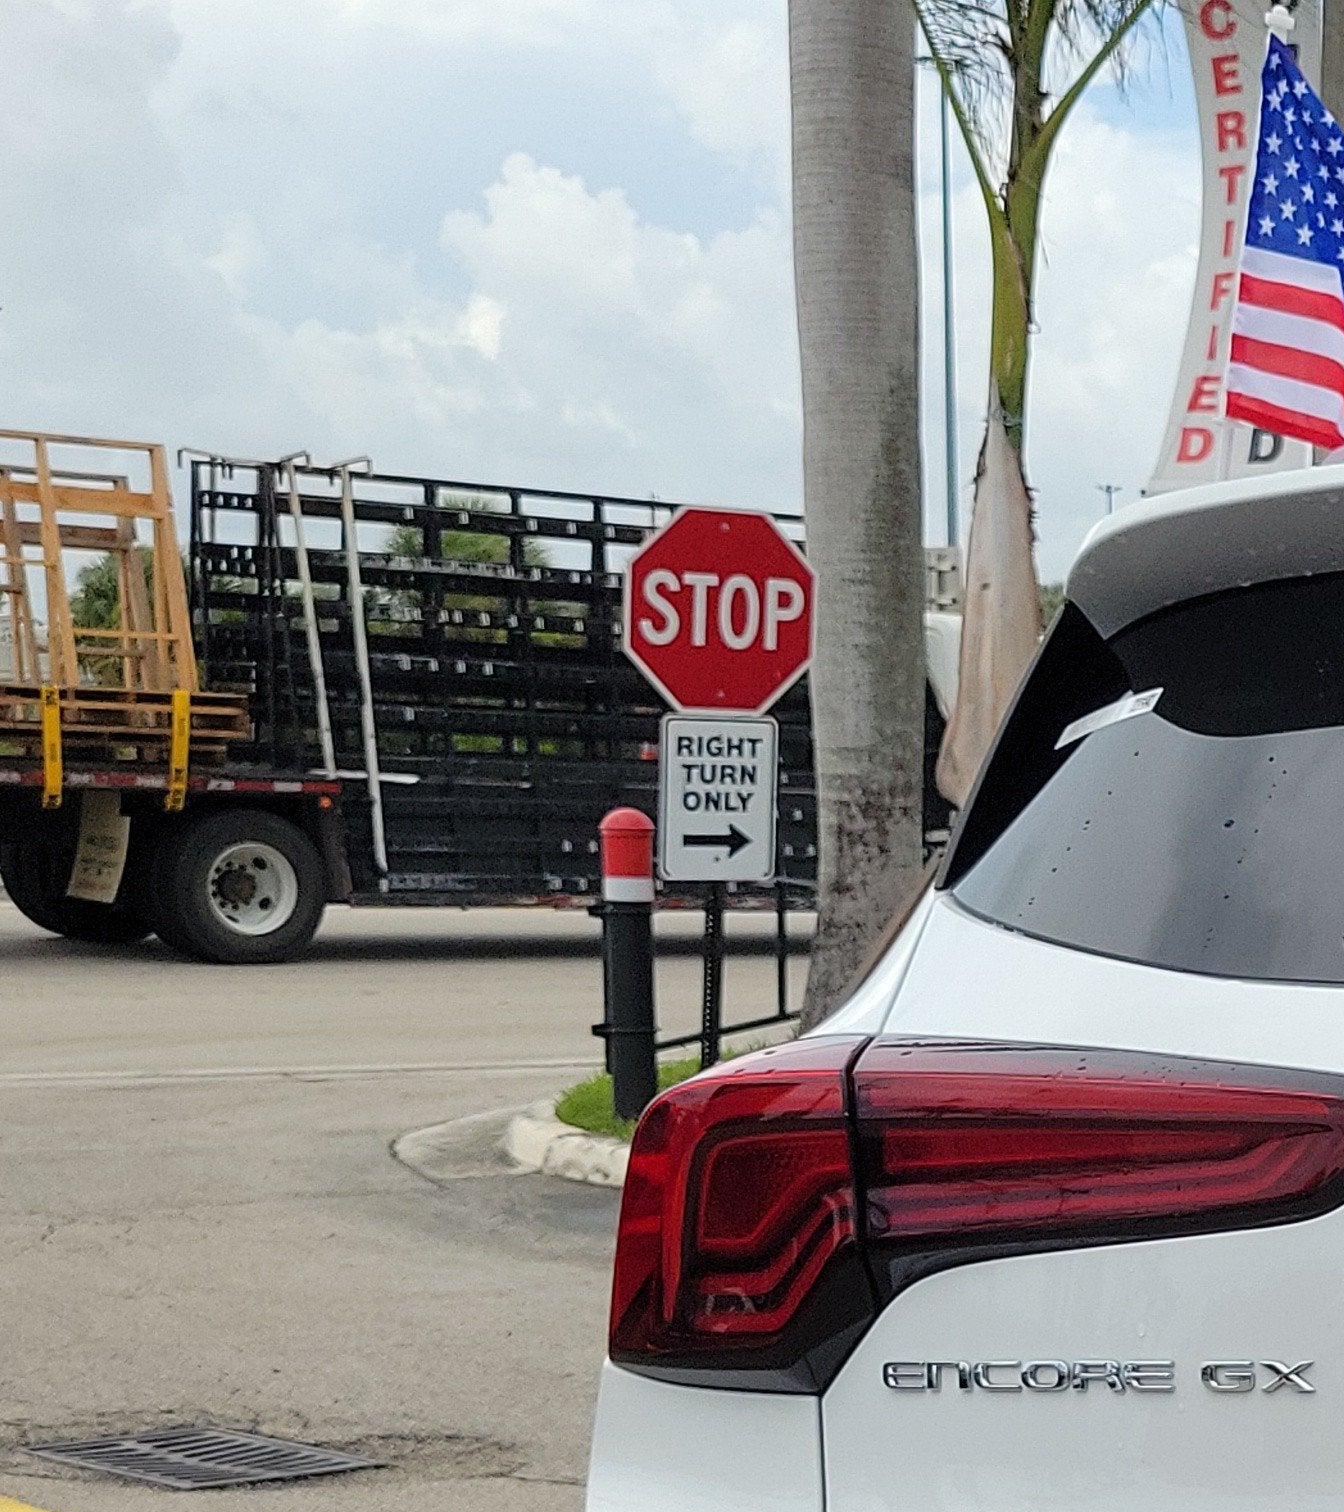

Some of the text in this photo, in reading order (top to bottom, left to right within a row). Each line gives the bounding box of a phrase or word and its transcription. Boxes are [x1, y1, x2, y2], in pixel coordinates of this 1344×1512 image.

[1176, 0, 1246, 463] CERTIFIED
[638, 568, 805, 652] STOP
[676, 736, 764, 759] RIGHT
[681, 764, 757, 785] TURN
[682, 790, 755, 812] ONLY
[882, 1358, 1317, 1394] ENCORE GX
